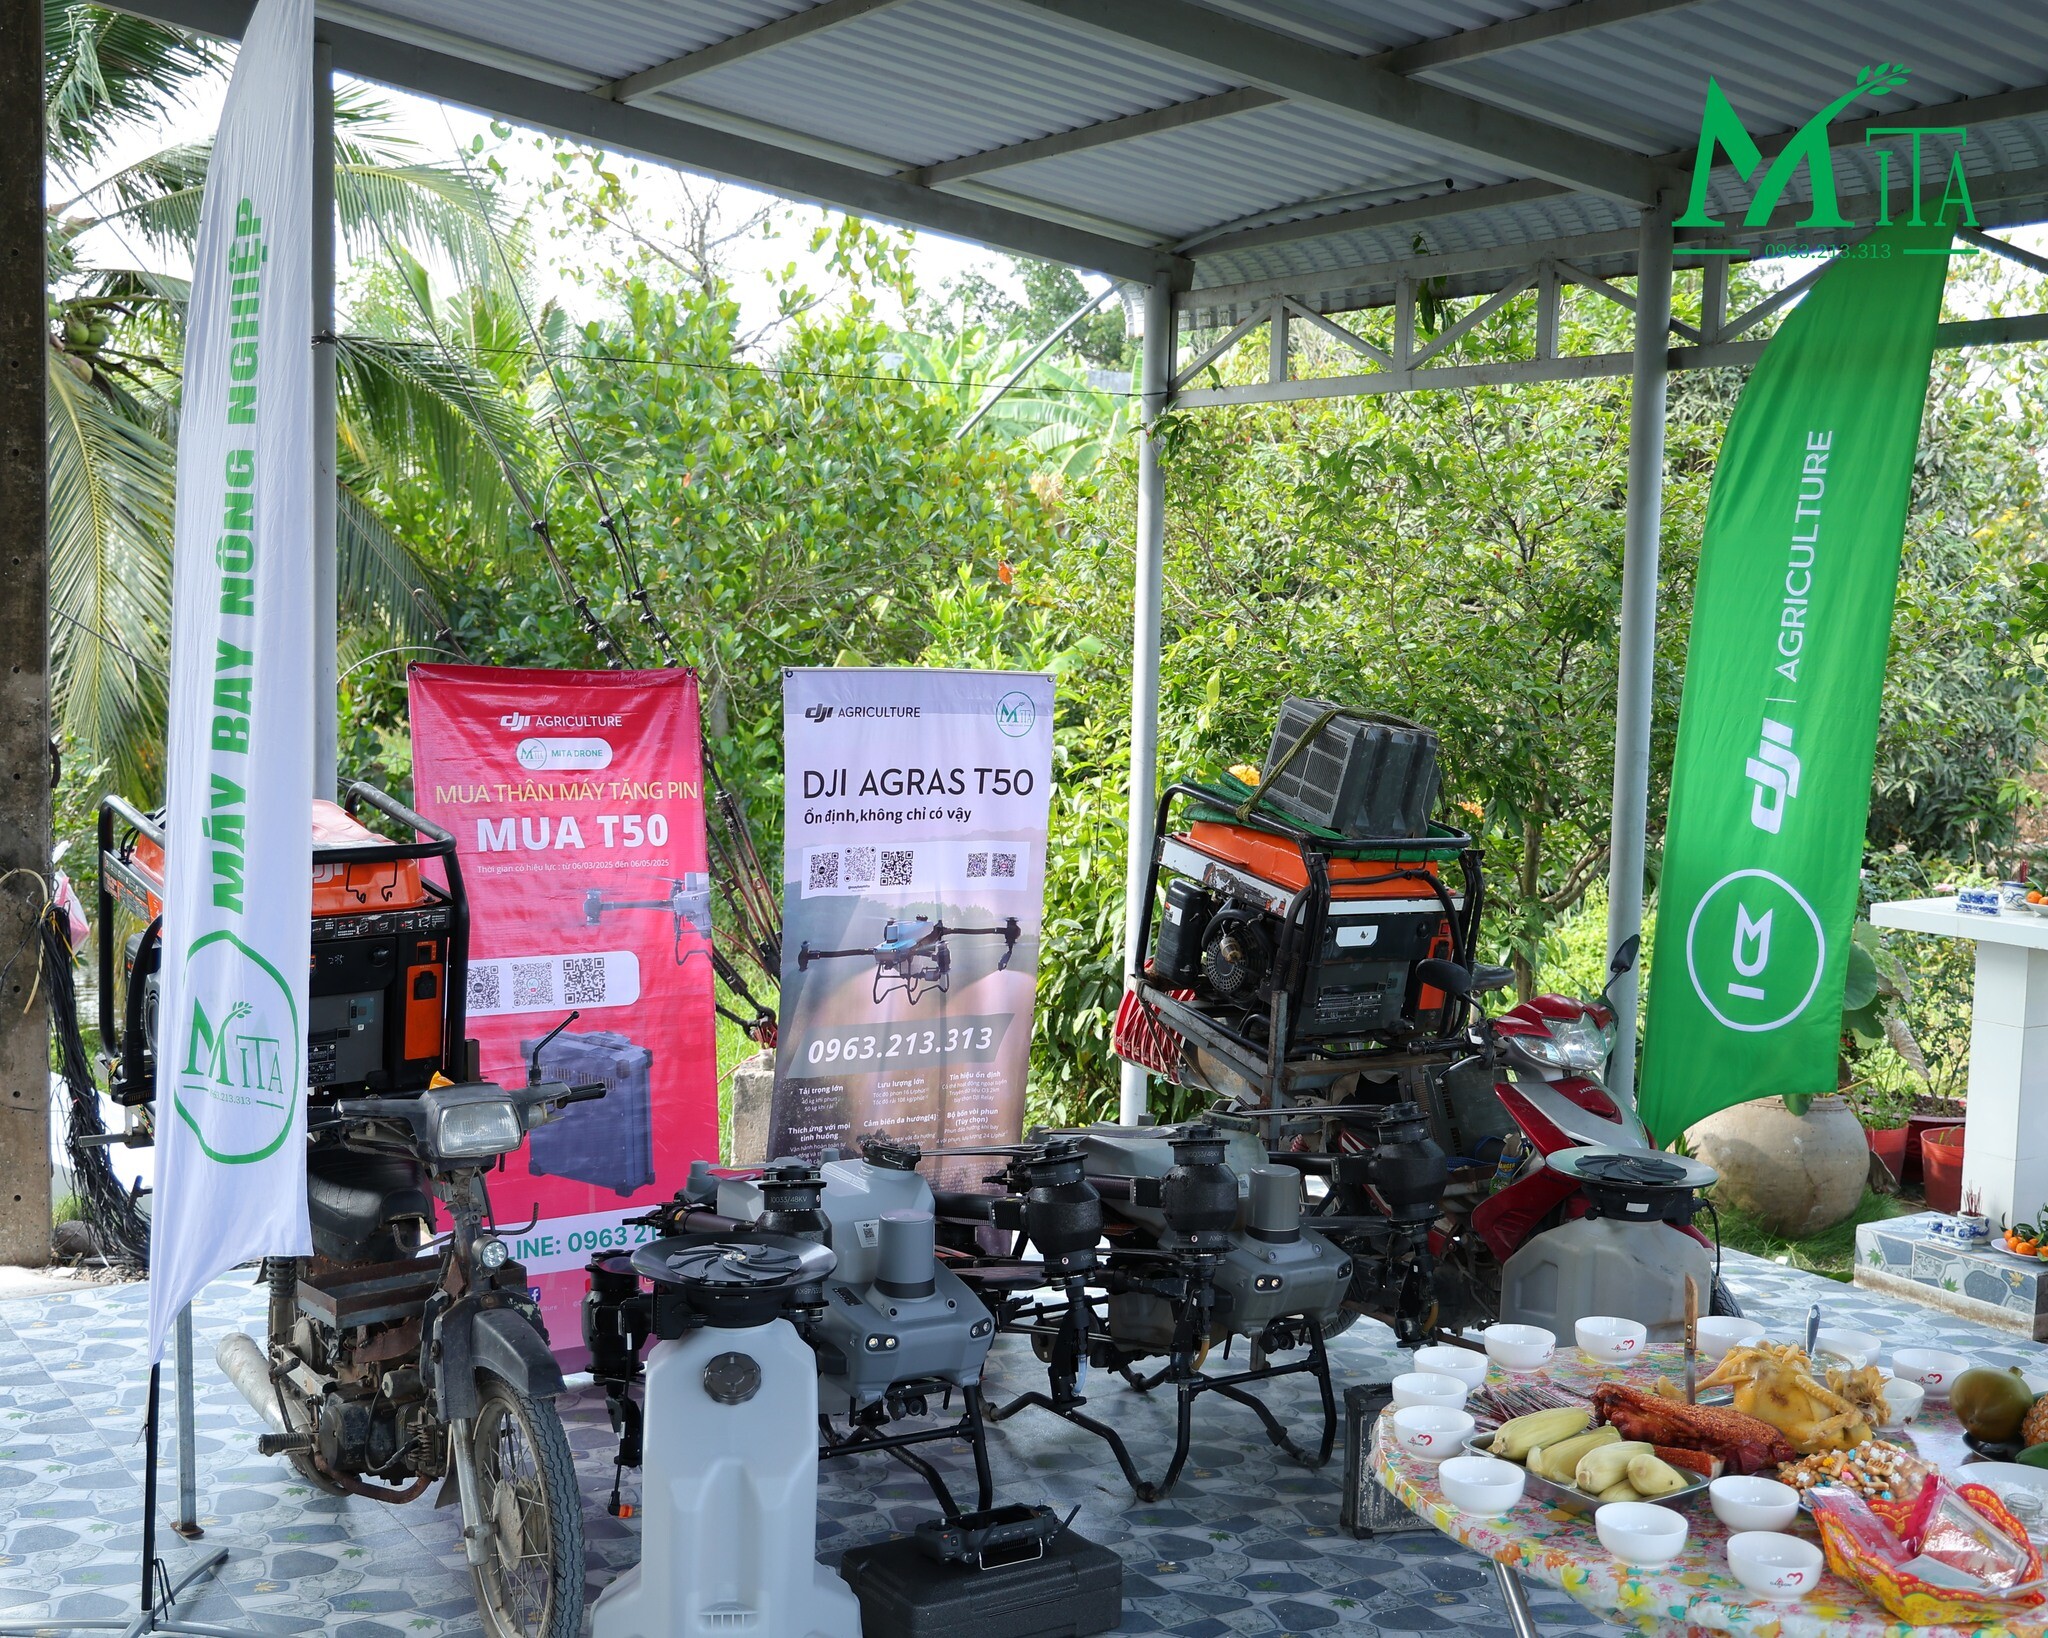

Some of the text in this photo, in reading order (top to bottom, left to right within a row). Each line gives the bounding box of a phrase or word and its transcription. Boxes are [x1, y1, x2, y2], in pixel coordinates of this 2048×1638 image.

[202, 197, 268, 915] MÁY BAY NÔNG NGHIỆP
[1774, 430, 1833, 684] AGRICULTURE
[535, 715, 622, 728] AGRICULTURE
[838, 706, 920, 718] AGRICULTURE
[436, 778, 698, 804] MUA THÂN MÁY TẶNG PIN
[804, 768, 1034, 798] DJI AGRAS T50
[804, 807, 822, 824] Ổn
[906, 806, 926, 820] chỉ
[929, 806, 942, 820] có
[947, 807, 971, 823] vậy
[477, 814, 669, 852] MUA T50
[496, 865, 514, 874] gian
[526, 864, 543, 872] hiệu
[572, 861, 613, 869] 06/03/2025
[615, 860, 629, 868] đến
[630, 859, 669, 868] 06/05/2025
[181, 996, 284, 1094] MITA
[808, 1027, 993, 1064] 0963.213.313
[568, 1226, 628, 1252] 0963
[634, 1224, 665, 1244] 21
